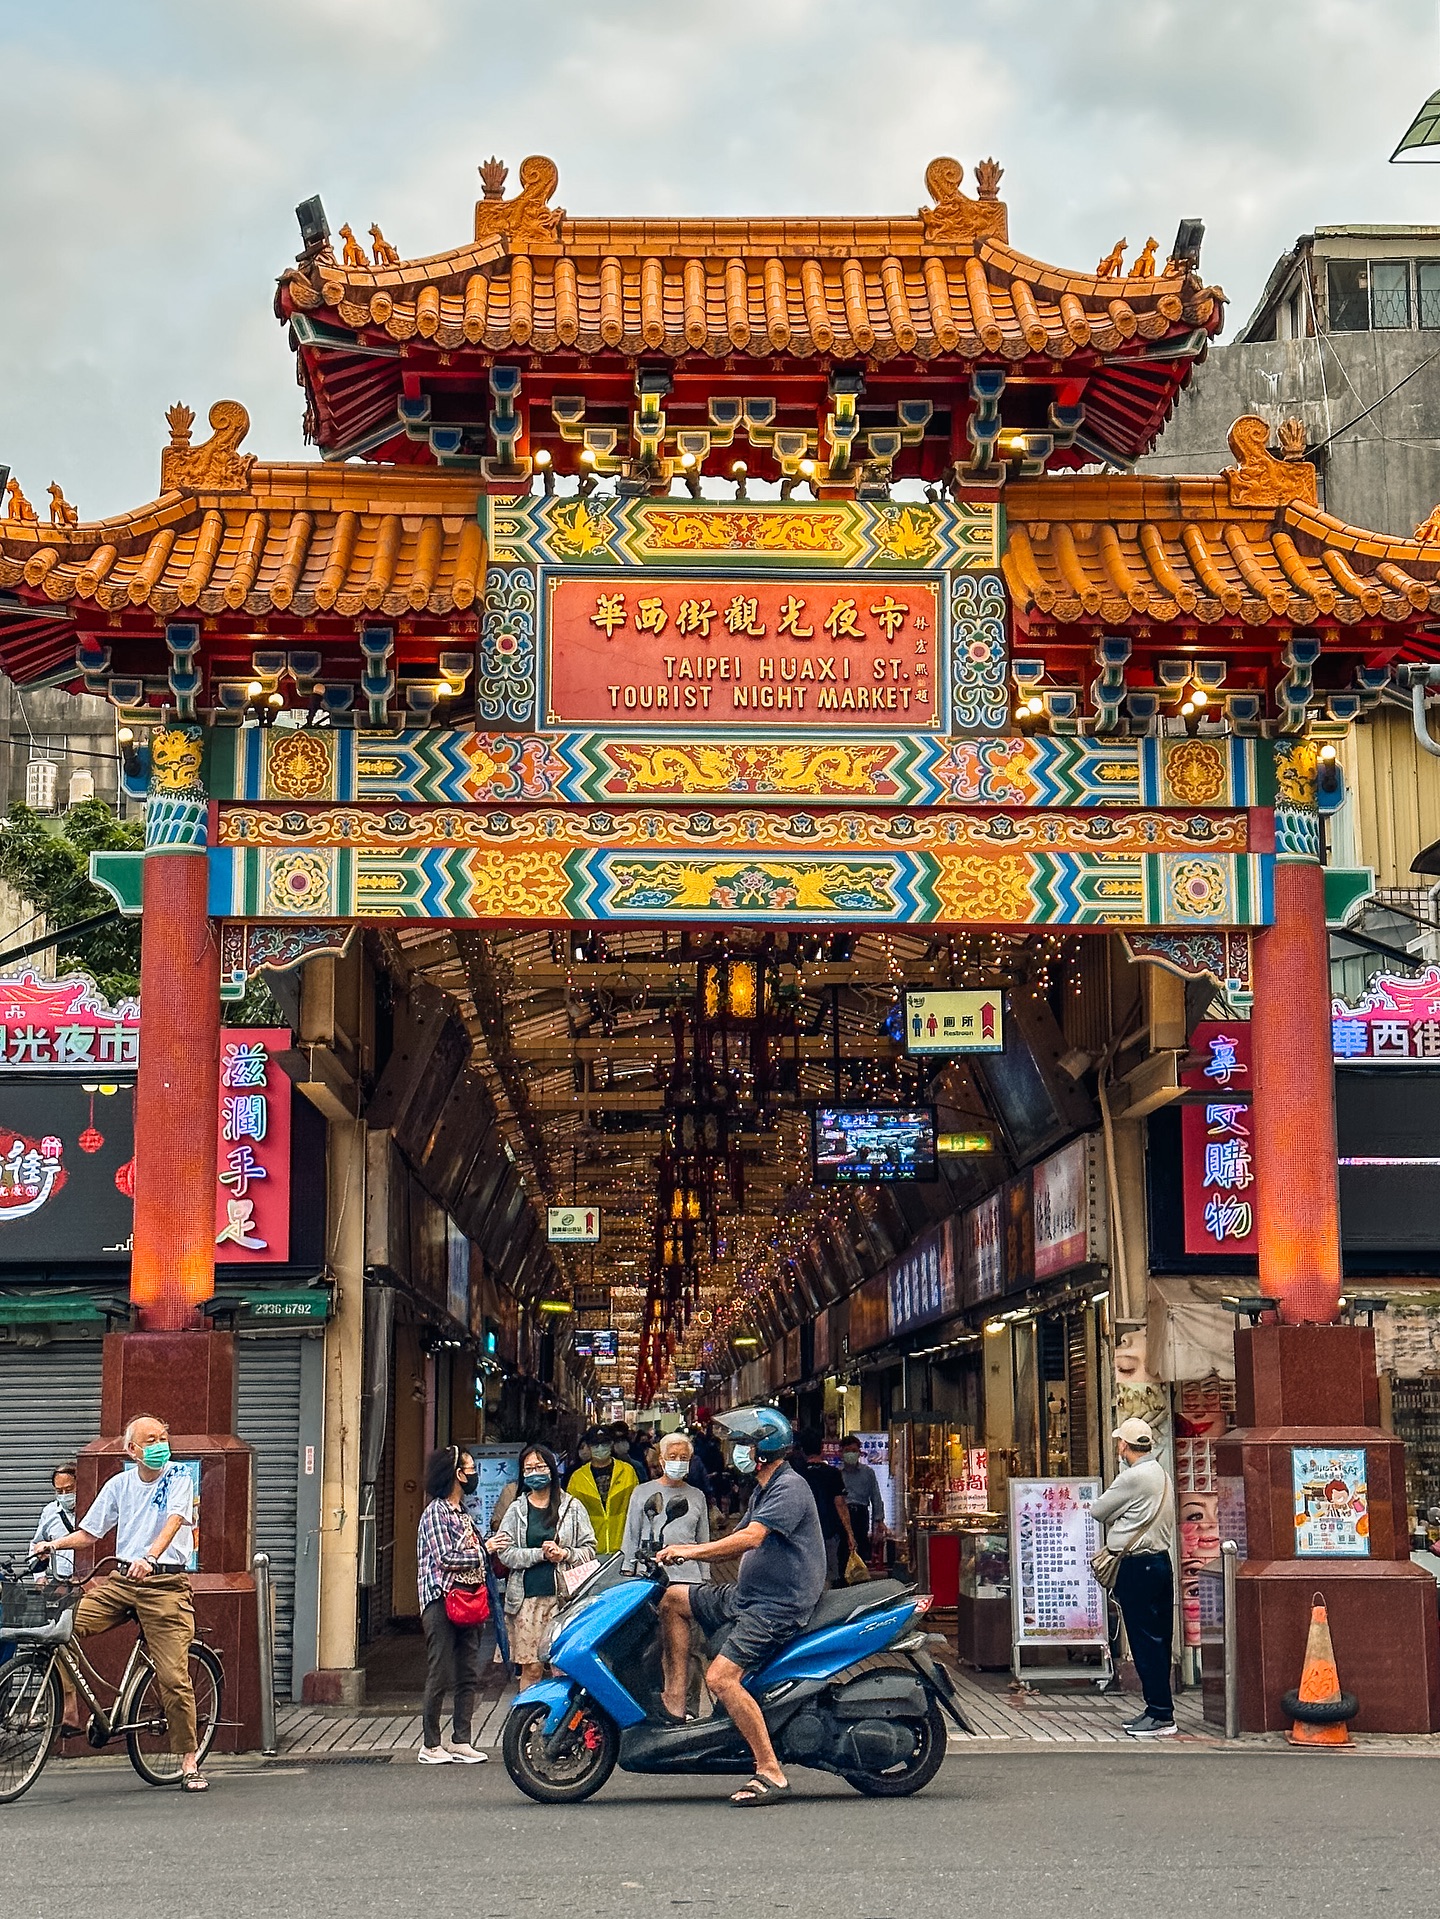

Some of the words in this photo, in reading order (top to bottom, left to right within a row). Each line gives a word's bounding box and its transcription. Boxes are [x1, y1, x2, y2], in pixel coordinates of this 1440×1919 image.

[590, 594, 909, 640] 華西街觀光夜市
[663, 655, 741, 681] TAIPEI
[759, 656, 850, 681] HUAXI
[873, 657, 909, 680] ST.
[607, 685, 712, 708] TOURIST
[733, 685, 807, 709] NIGHT
[817, 685, 912, 709] MARKET
[215, 1042, 269, 1250] 滋潤手足
